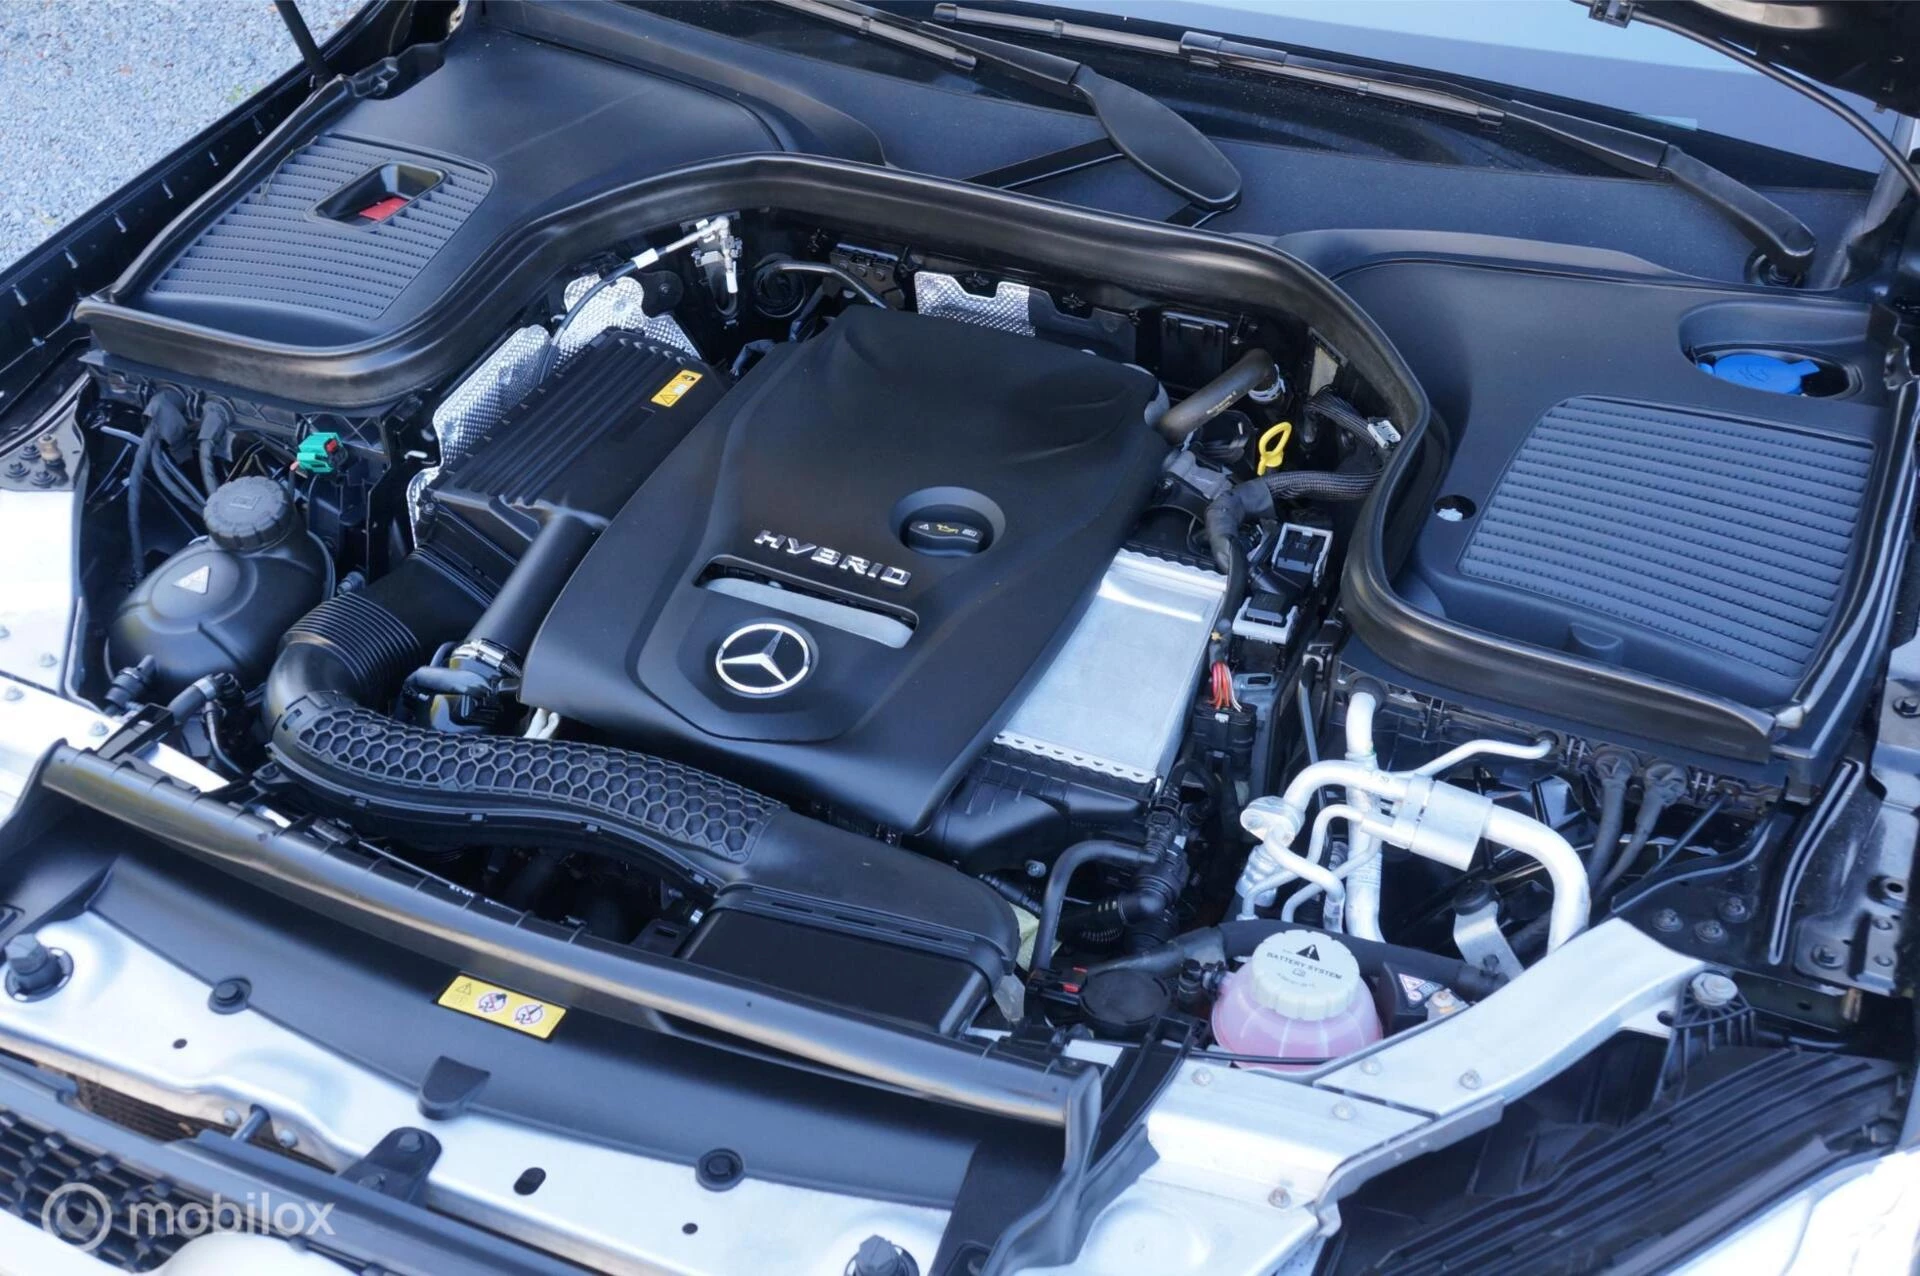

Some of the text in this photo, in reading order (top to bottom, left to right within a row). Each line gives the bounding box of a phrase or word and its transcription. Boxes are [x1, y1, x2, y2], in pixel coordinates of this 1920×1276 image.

[754, 529, 912, 586] HYBRID
[1266, 952, 1306, 968] BATTERY
[1307, 964, 1343, 980] SYSTEM
